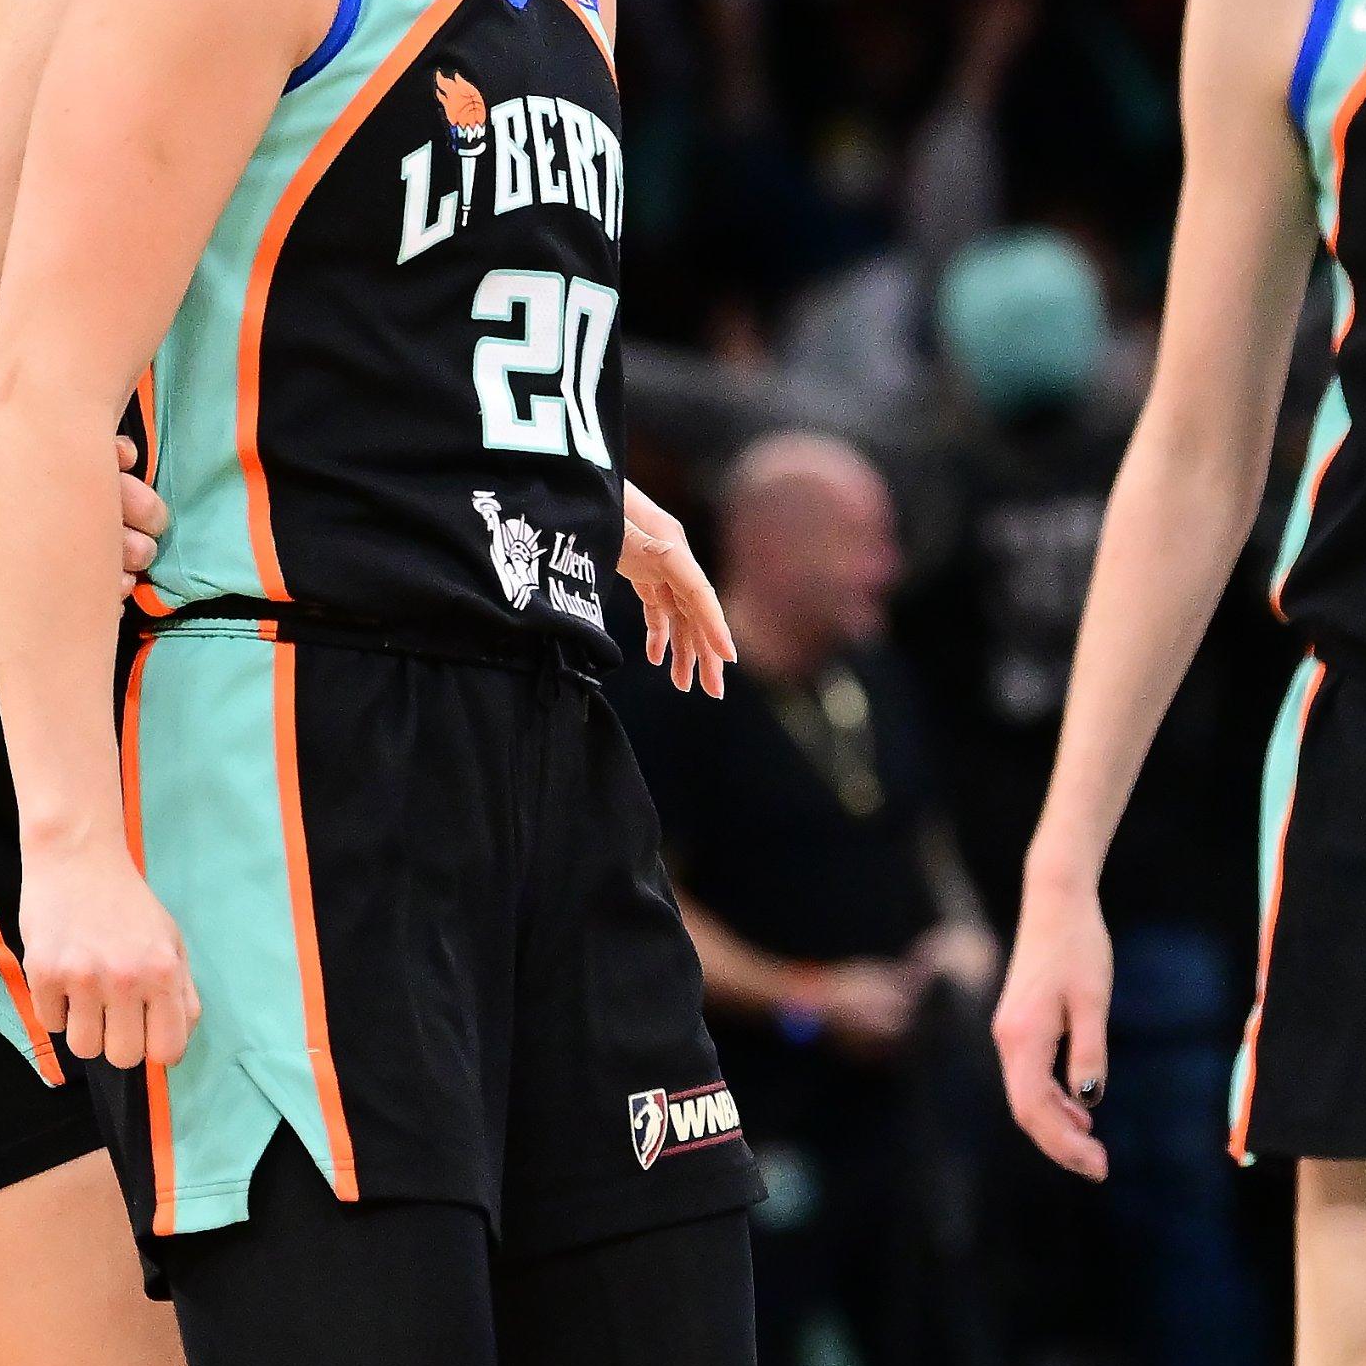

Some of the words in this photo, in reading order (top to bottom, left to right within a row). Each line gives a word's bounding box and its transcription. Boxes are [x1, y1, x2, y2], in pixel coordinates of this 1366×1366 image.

[396, 68, 625, 266] LIBERT
[471, 268, 619, 470] 20
[548, 576, 605, 632] Mutual
[549, 531, 596, 593] Liberty
